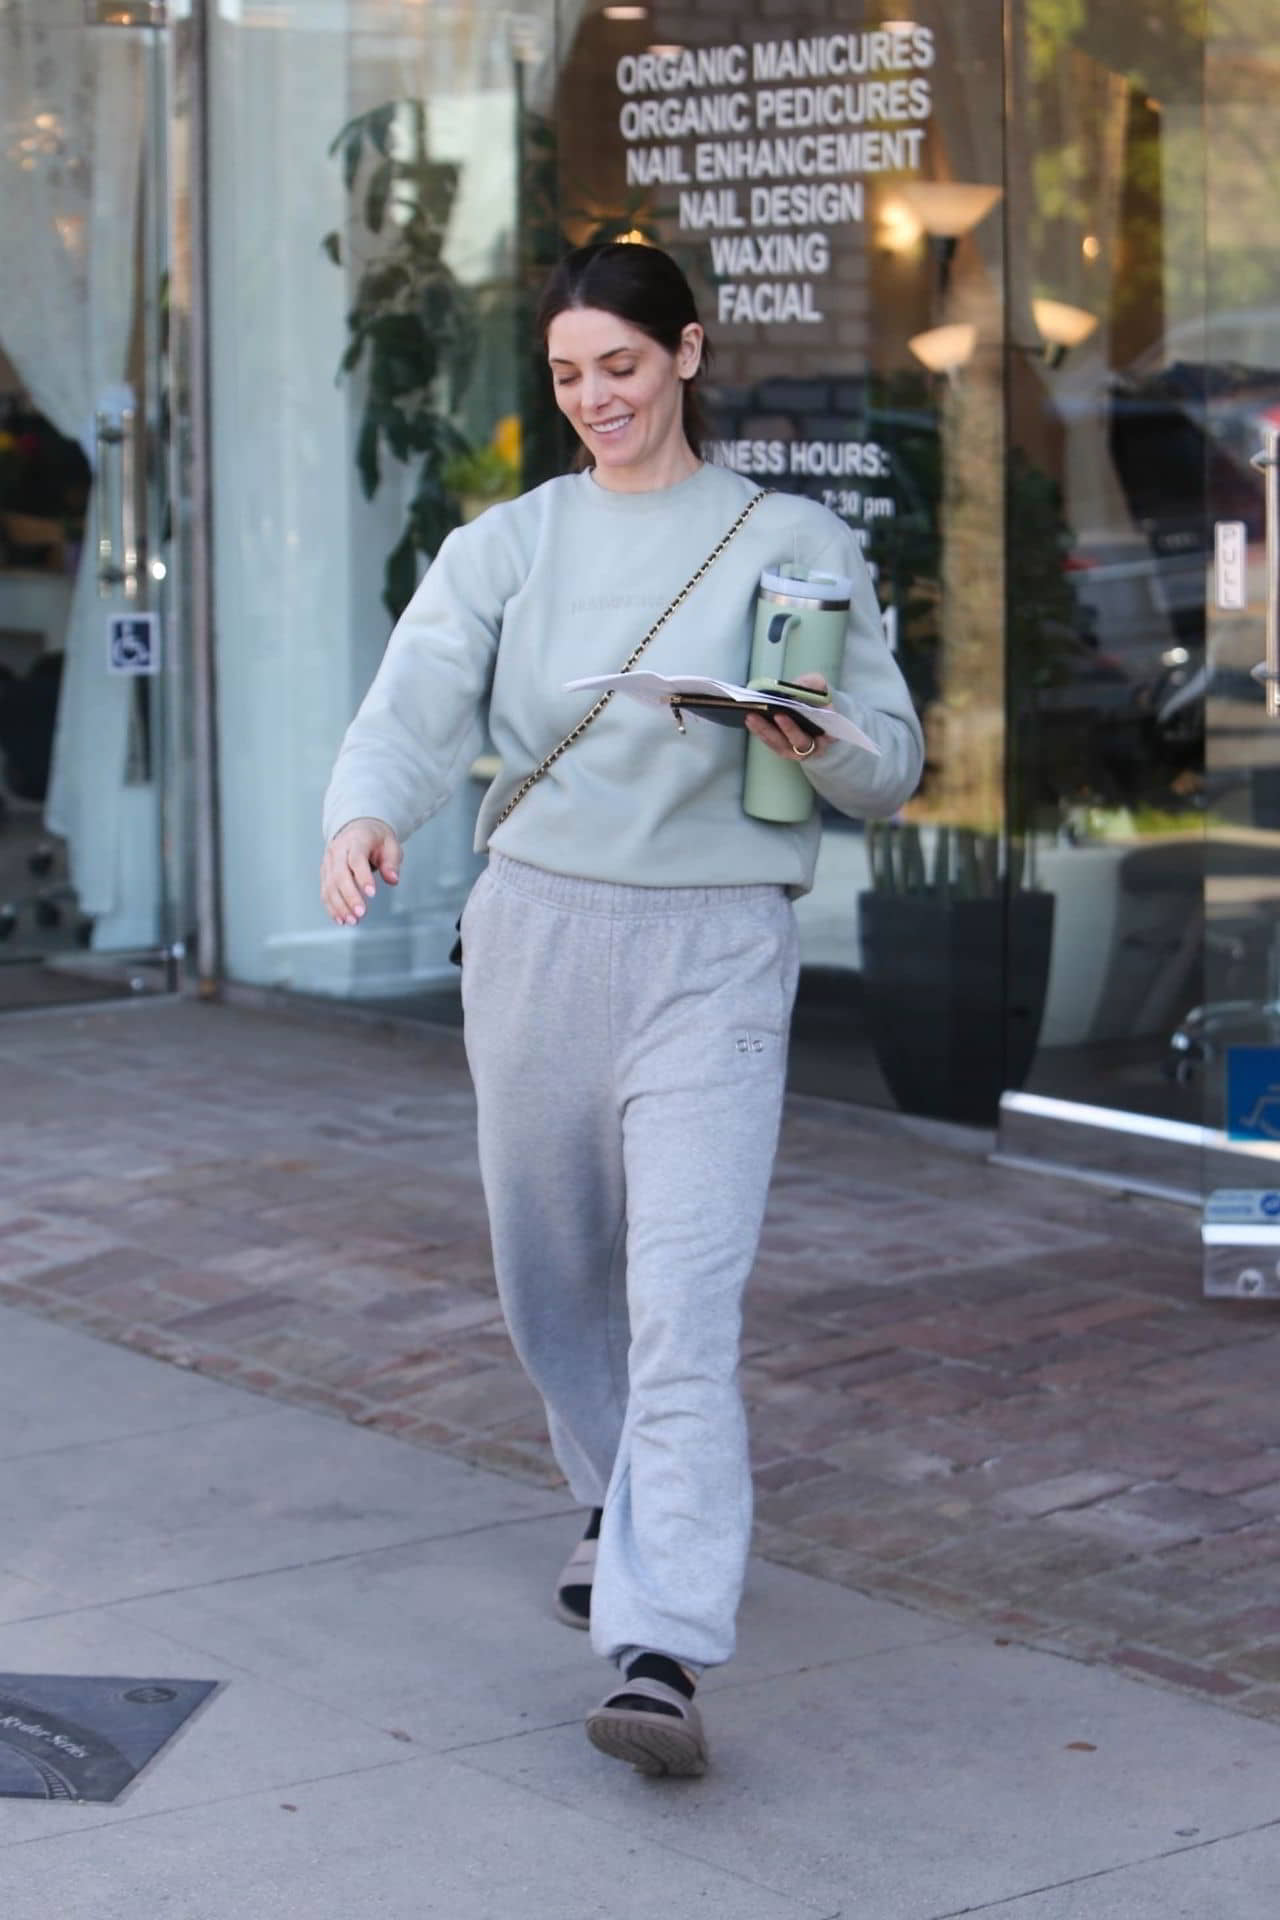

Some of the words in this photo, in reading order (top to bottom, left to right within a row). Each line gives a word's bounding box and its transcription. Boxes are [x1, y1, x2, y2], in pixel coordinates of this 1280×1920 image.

[616, 45, 746, 93] ORGANIC
[753, 27, 935, 80] MANICURES
[620, 93, 749, 139] ORGANIC
[757, 79, 931, 129] PEDICURES
[627, 147, 690, 185] NAIL
[696, 129, 924, 181] ENHANCEMENT
[680, 190, 745, 229] NAIL
[751, 183, 862, 227] DESIGN
[711, 233, 828, 275] WAXING
[718, 283, 821, 323] FACIAL
[790, 441, 891, 477] HOURS:
[863, 497, 893, 522] pm
